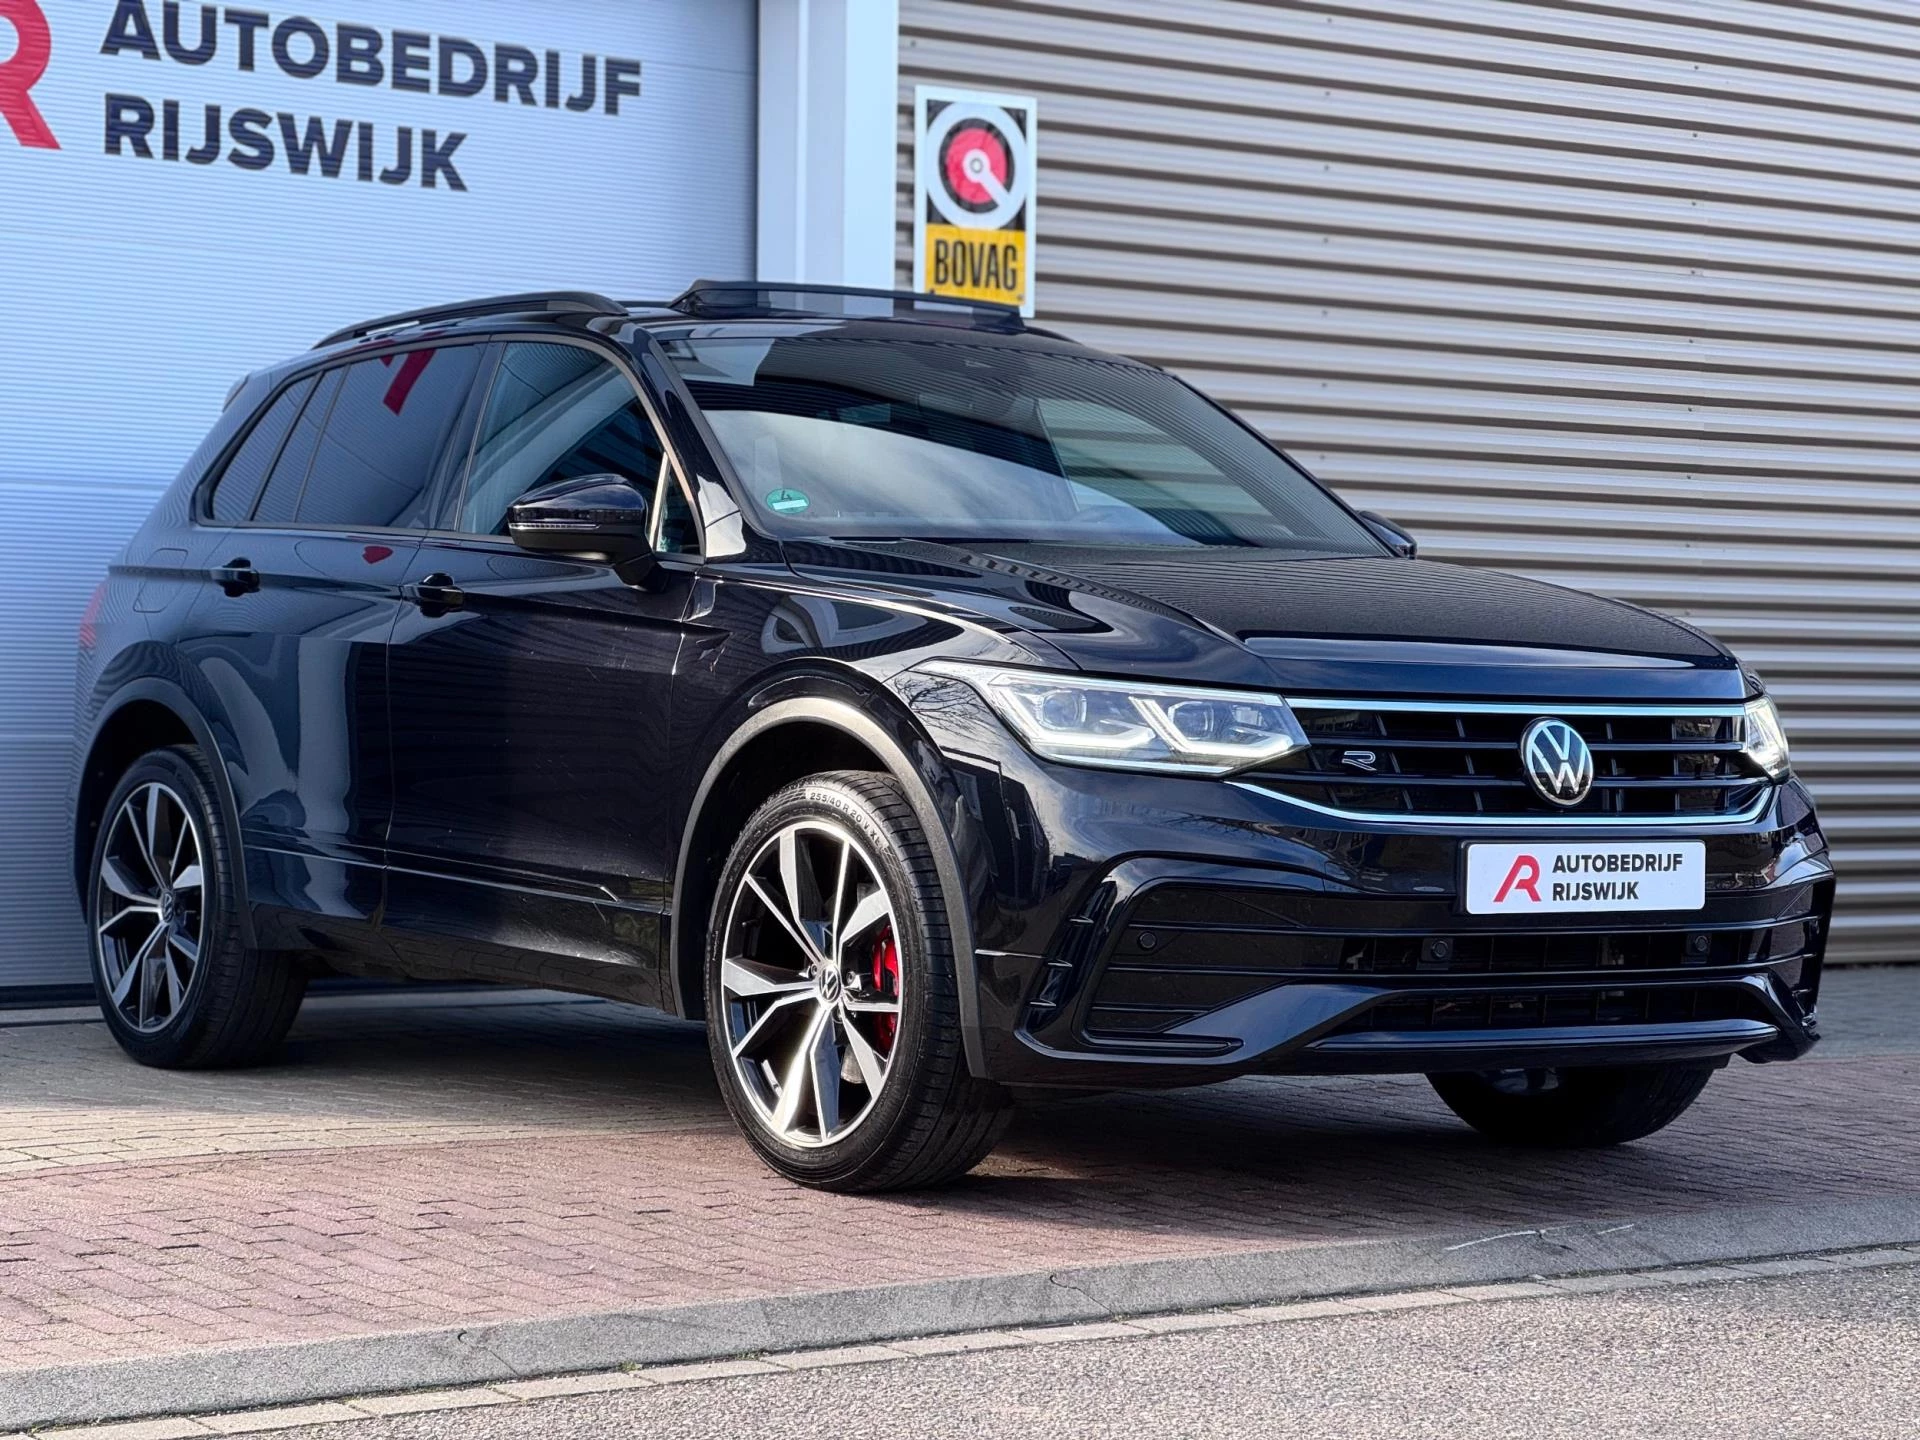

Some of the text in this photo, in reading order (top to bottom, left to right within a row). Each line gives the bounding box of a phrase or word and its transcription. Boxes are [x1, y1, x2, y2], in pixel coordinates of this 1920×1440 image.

[100, 0, 641, 116] AUTOBEDRIJF
[105, 93, 468, 192] RIJSWIJK
[934, 239, 1018, 291] BOVAG
[1342, 751, 1377, 771] R
[810, 792, 841, 807] 255/40
[843, 804, 850, 814] R
[850, 811, 862, 822] 20
[1552, 853, 1684, 874] AUTOBEDRIJF
[1553, 881, 1640, 902] RIJSWIJK
